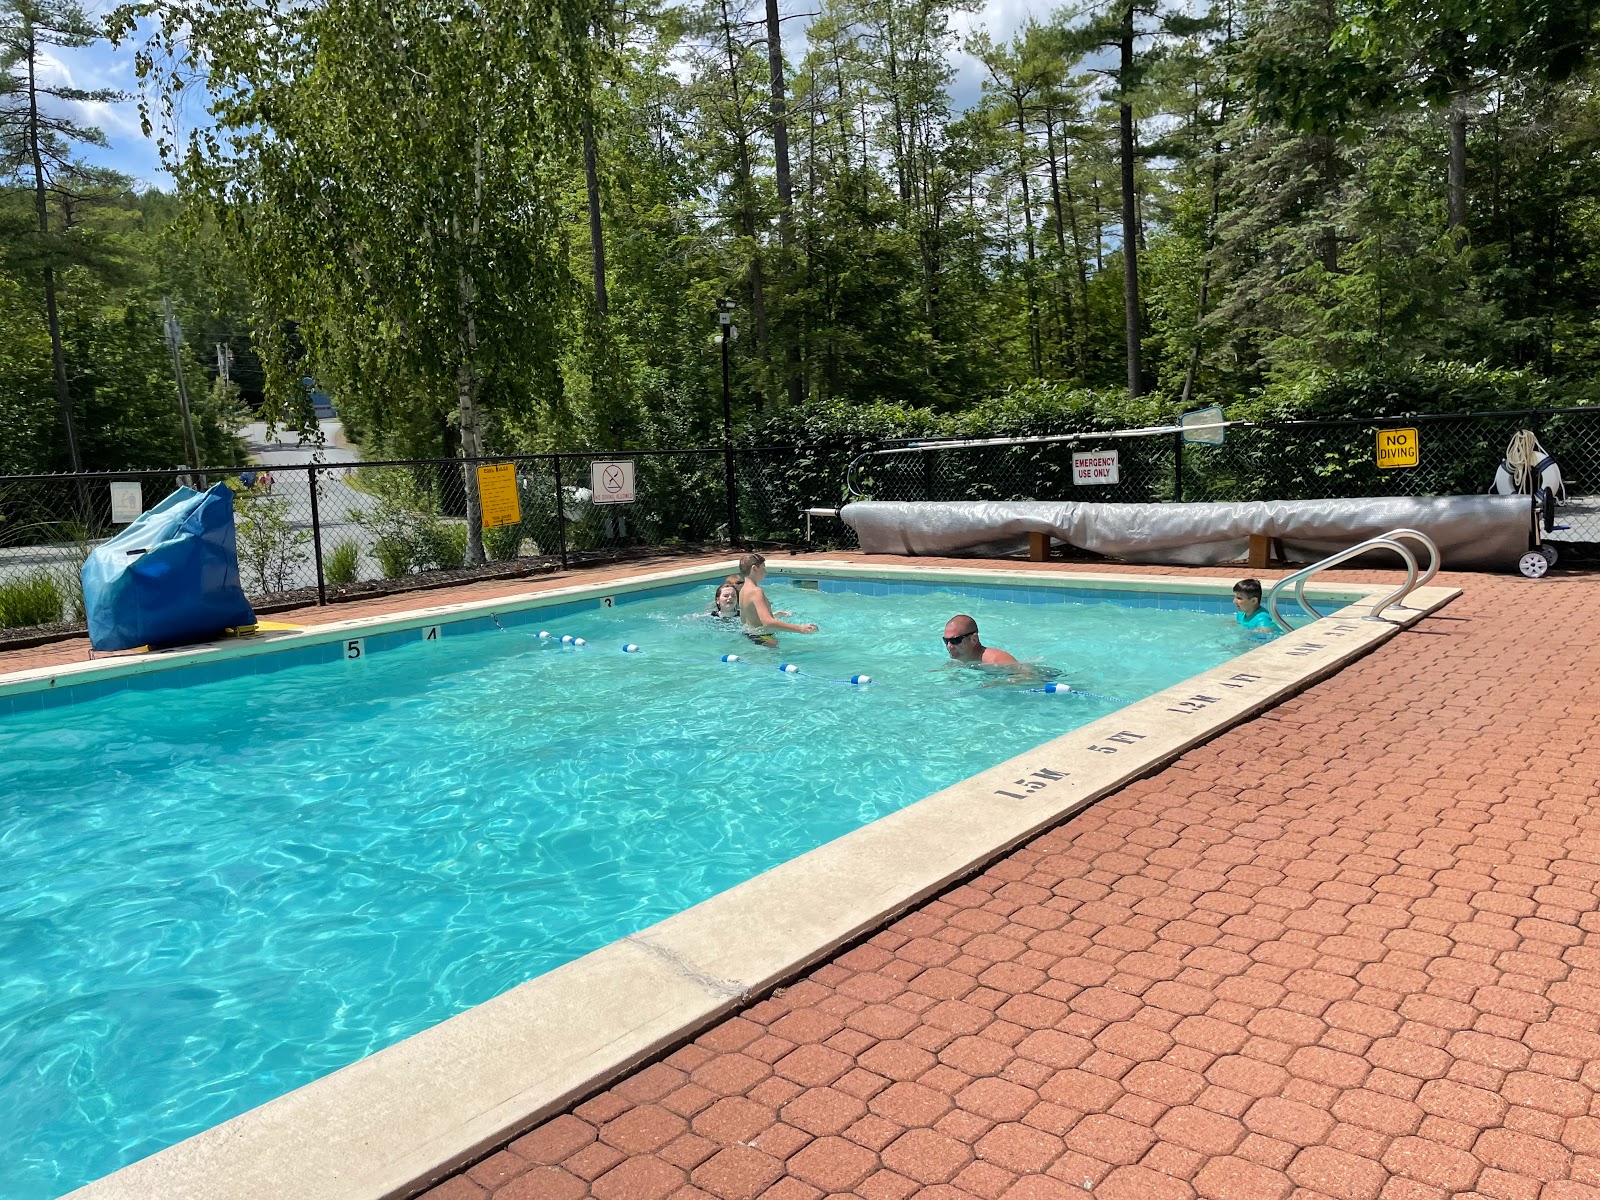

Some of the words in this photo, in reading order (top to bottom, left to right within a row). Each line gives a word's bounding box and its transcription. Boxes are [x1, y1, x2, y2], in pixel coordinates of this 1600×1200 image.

[1386, 434, 1407, 446] NO
[1380, 446, 1415, 459] DIVING
[1074, 457, 1115, 467] EMERGENCY
[1078, 469, 1091, 478] USE
[1093, 468, 1110, 477] ONLY
[348, 640, 360, 659] 5
[1229, 673, 1262, 682] FT
[1087, 744, 1118, 754] 5
[1105, 730, 1147, 745] FT
